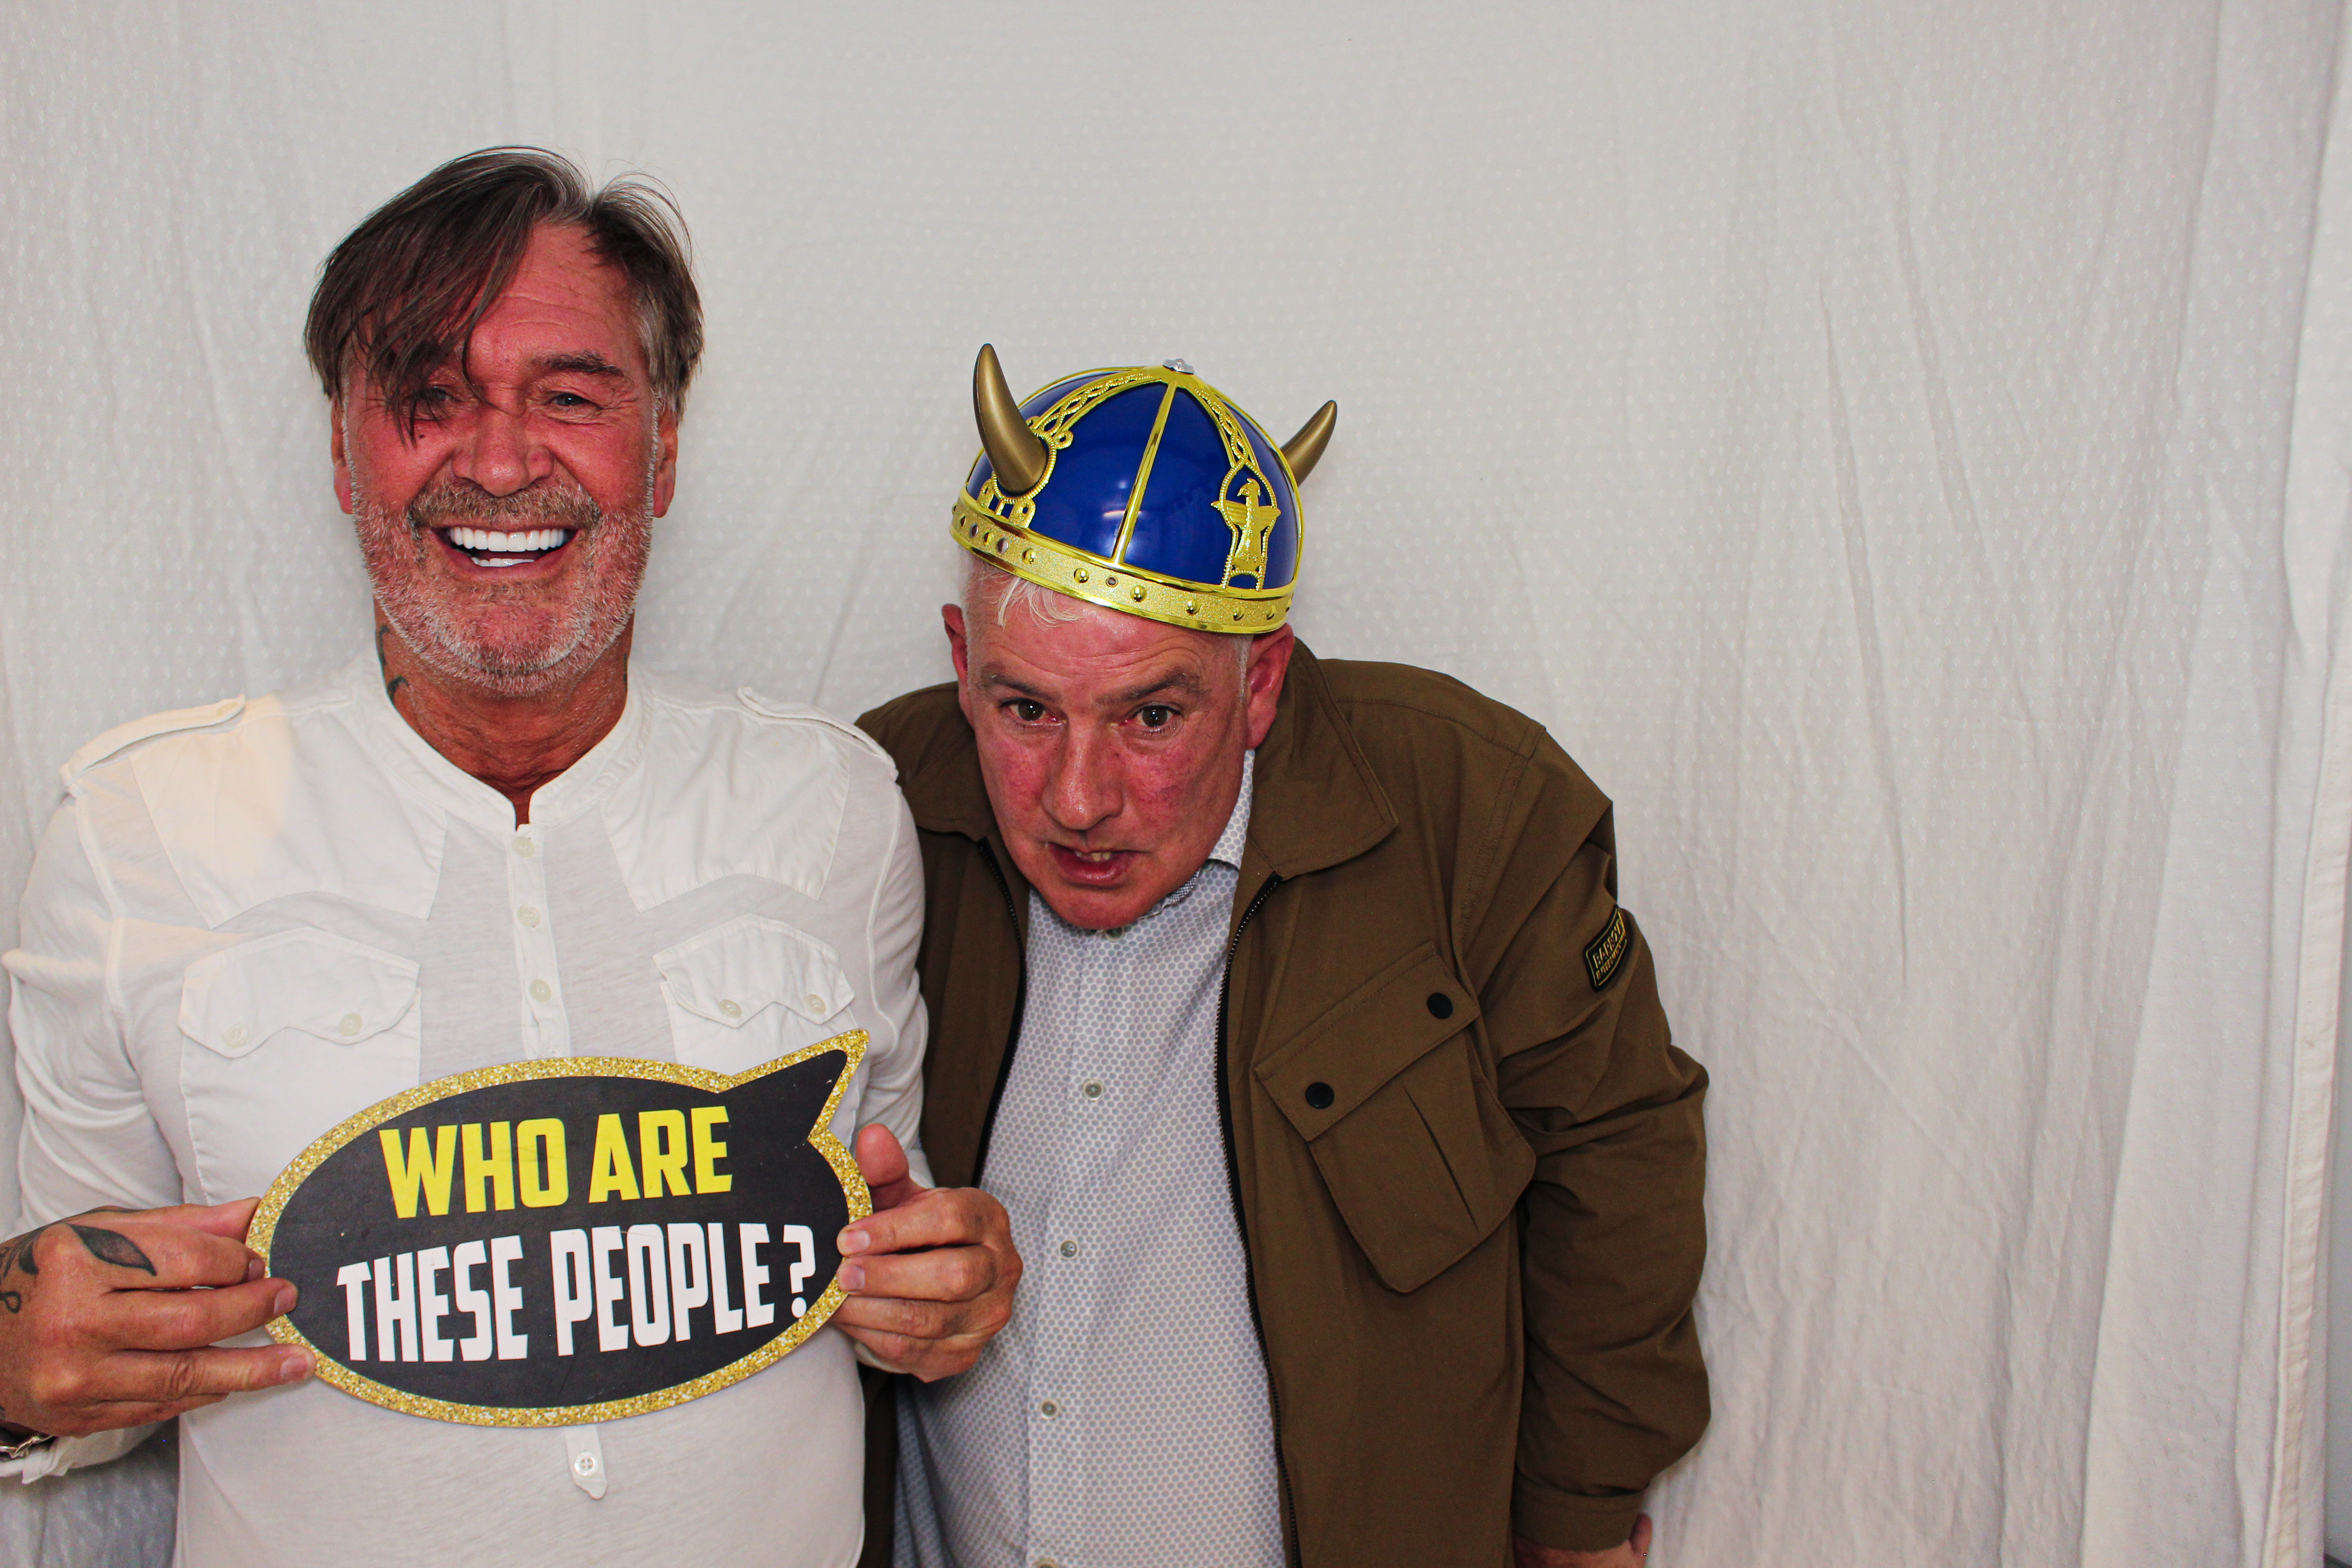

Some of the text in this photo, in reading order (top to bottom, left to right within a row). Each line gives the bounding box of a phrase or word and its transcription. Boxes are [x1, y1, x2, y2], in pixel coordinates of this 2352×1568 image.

[379, 1106, 732, 1218] WHO ARE
[336, 1223, 816, 1362] THESE PEOPLE?
